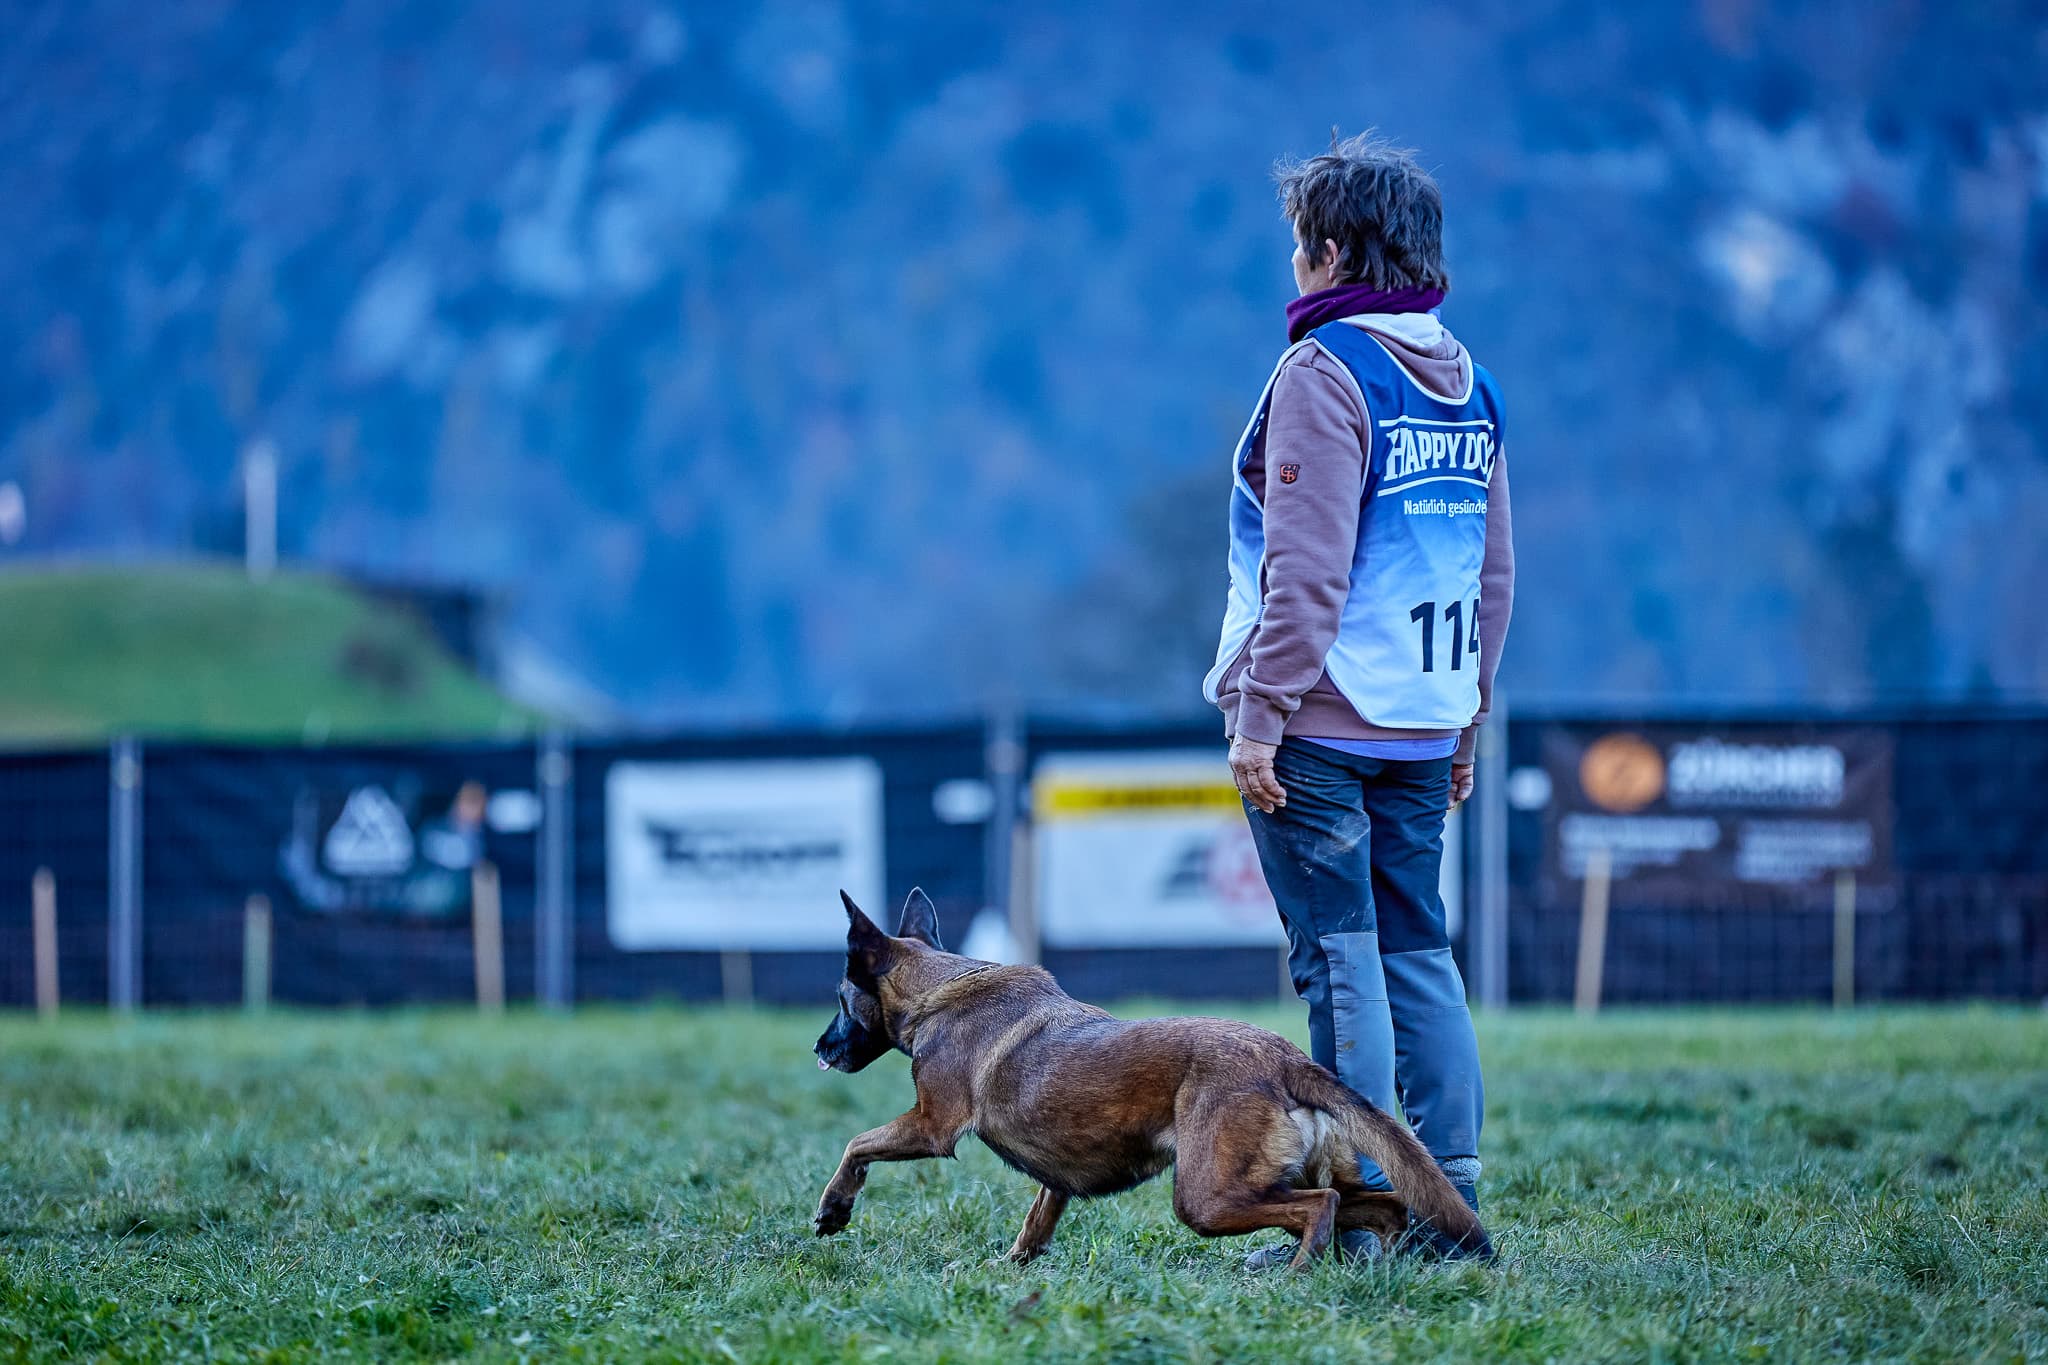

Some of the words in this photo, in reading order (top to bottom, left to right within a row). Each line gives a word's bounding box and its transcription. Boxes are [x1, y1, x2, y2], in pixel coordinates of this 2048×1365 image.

[1384, 427, 1463, 481] HAPPY
[1404, 499, 1447, 515] Natürlich
[1448, 499, 1488, 517] gesünde
